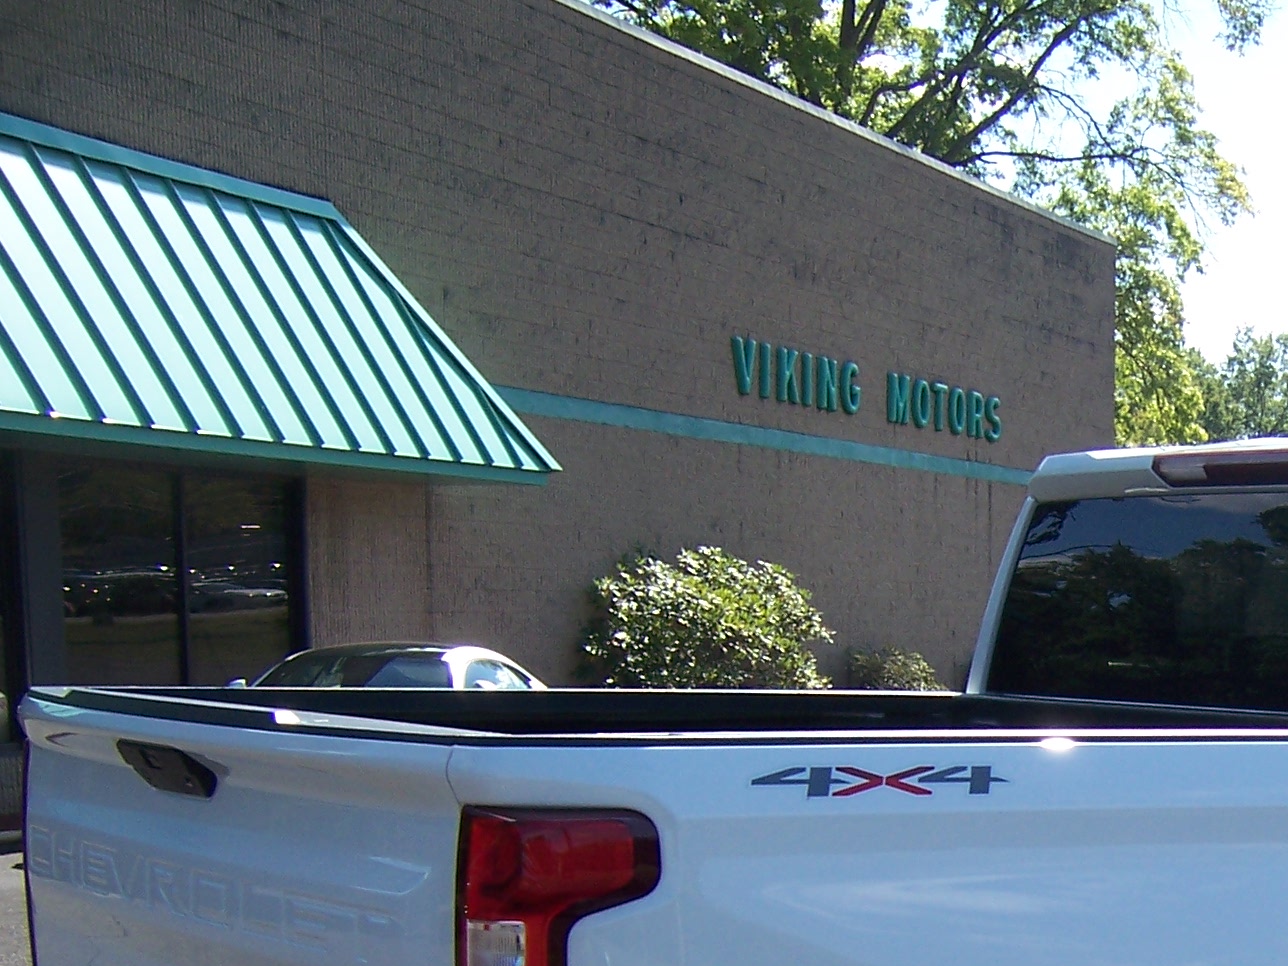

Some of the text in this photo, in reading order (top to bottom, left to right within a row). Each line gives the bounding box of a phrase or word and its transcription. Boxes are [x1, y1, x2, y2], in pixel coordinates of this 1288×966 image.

[730, 335, 1002, 443] VIKING MOTORS
[29, 824, 408, 964] CHEVROLET
